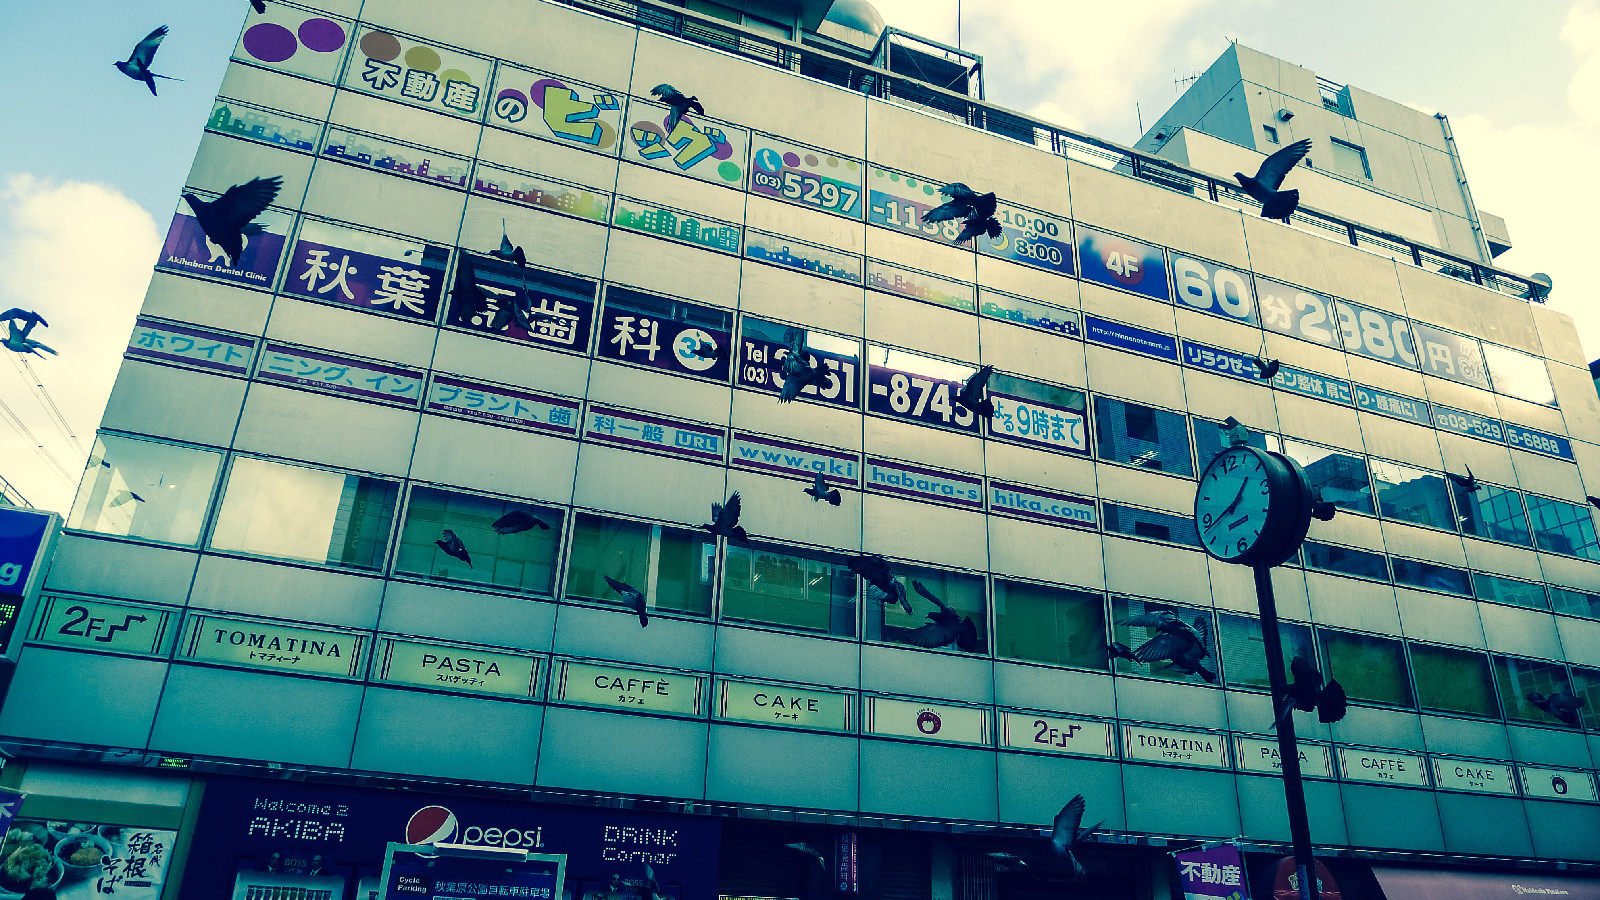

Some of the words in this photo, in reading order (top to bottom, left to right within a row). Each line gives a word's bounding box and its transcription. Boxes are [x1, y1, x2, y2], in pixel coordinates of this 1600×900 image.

[1002, 210, 1059, 237] 10:00
[1014, 237, 1063, 265] 8:00
[166, 255, 213, 273] Akihabara
[215, 264, 243, 278] Dental
[245, 269, 267, 282] Clinic
[1105, 251, 1139, 278] 4F
[745, 341, 769, 364] Tel
[993, 400, 1082, 445] よる9時まで
[678, 432, 717, 451] URL
[1220, 455, 1239, 475] 12
[1260, 479, 1270, 495] 3
[1202, 512, 1213, 528] 9
[1236, 537, 1248, 553] 6
[58, 606, 105, 638] 2F
[215, 629, 342, 658] TOMATINA
[249, 651, 301, 665] トマティーナ
[422, 654, 502, 677] PASTA
[436, 674, 485, 687] スパゲッティ
[594, 675, 670, 697] CAFFÈ
[618, 694, 645, 705] カフェ
[753, 693, 820, 713] CAKE
[774, 710, 799, 722] ケーキ
[1033, 719, 1059, 744] 2F
[1137, 734, 1214, 754] TOMATINA
[1161, 750, 1193, 760] トマティーナ
[1260, 747, 1309, 763] PAA
[1361, 757, 1406, 773] CAFFÈ
[1454, 766, 1495, 781] CAKE
[254, 797, 331, 816] Welcome
[249, 816, 346, 842] AKIBA
[463, 826, 541, 849] pepsi
[399, 876, 420, 884] Cycle
[1180, 860, 1242, 887] 不動産
[397, 884, 427, 894] Parking
